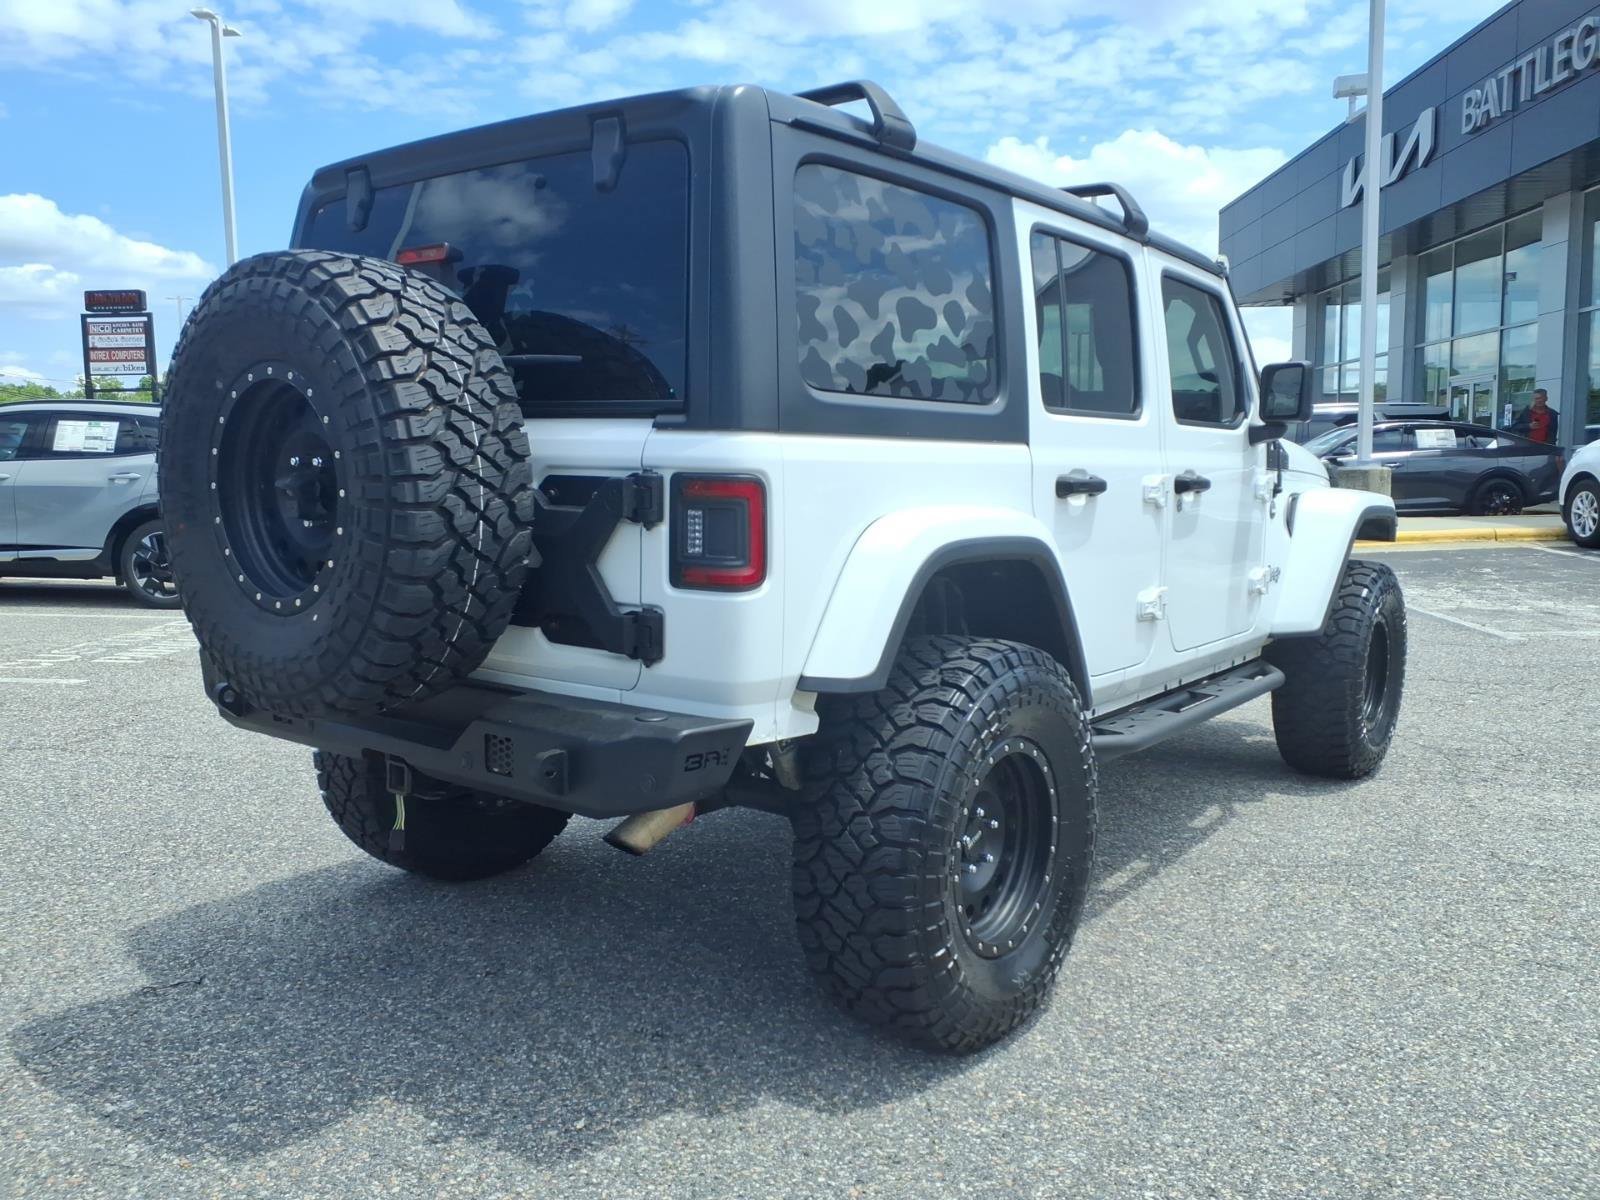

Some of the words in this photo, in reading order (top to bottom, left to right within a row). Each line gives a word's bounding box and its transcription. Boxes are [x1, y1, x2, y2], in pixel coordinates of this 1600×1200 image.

[1461, 16, 1600, 134] BATTLEG
[111, 350, 145, 361] COMPUTERS
[122, 364, 145, 372] bikes
